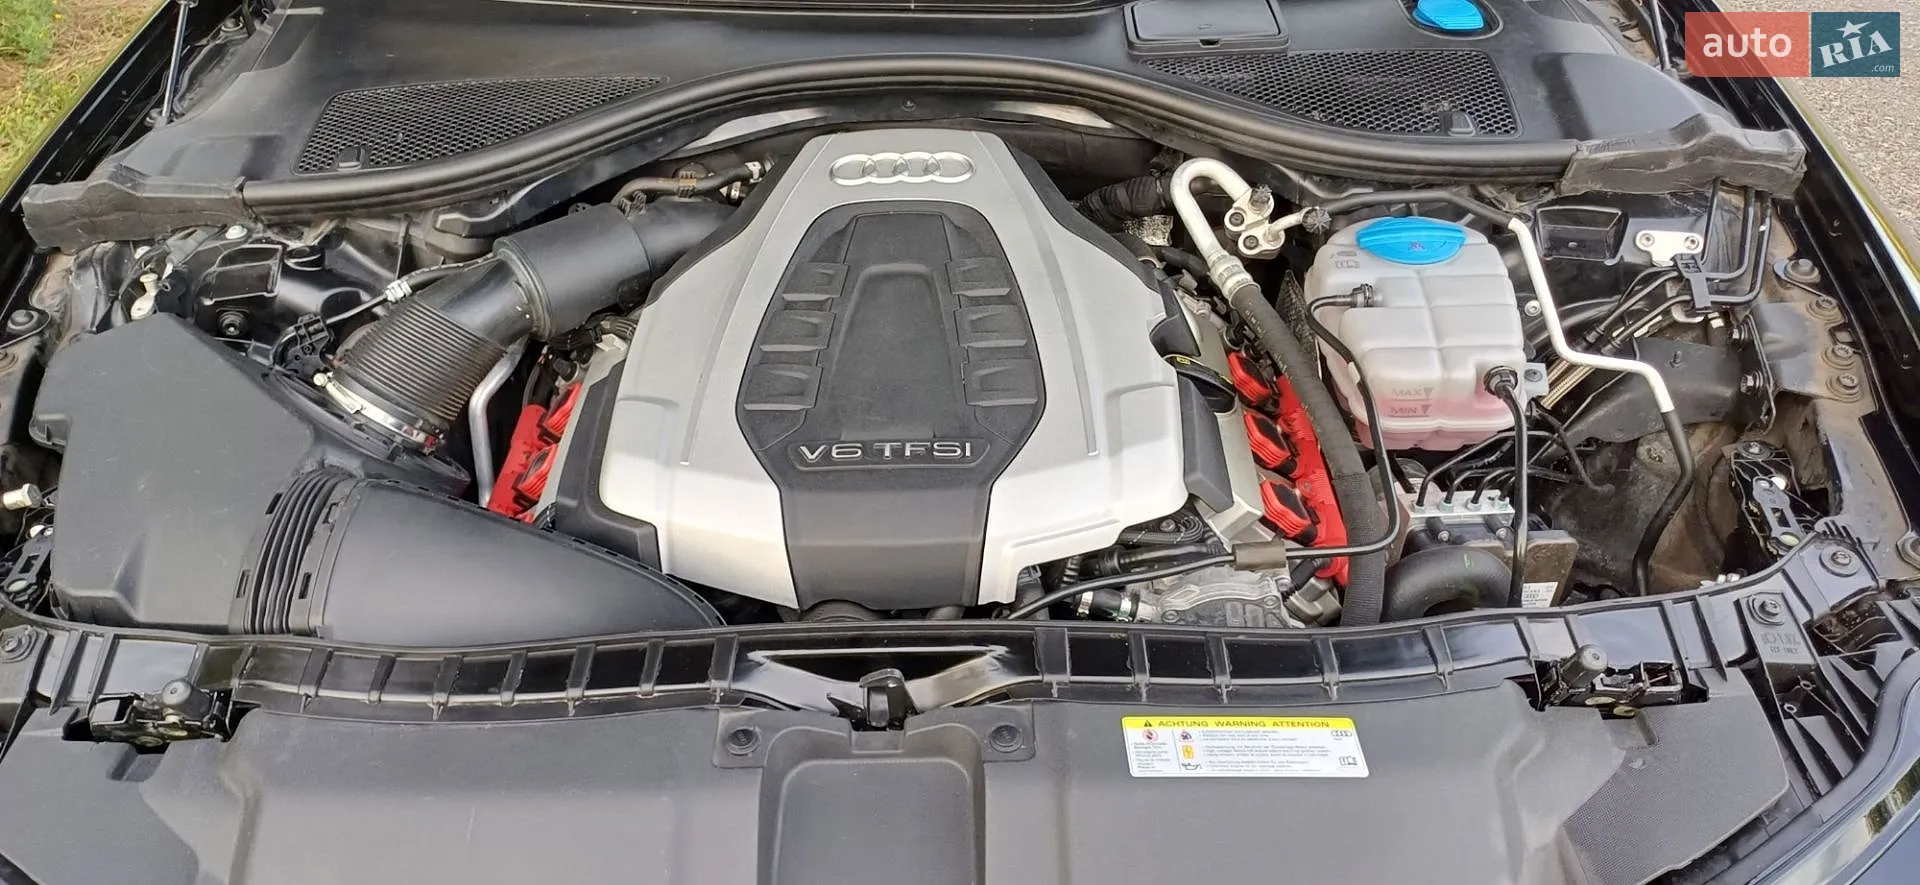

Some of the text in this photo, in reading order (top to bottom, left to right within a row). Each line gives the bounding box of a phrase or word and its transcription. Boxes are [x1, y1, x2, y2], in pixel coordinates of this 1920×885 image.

[1391, 388, 1423, 396] MAX
[799, 442, 971, 463] V6 TFSI
[1214, 720, 1266, 728] WARNING
[1272, 720, 1330, 728] ATTENTION
